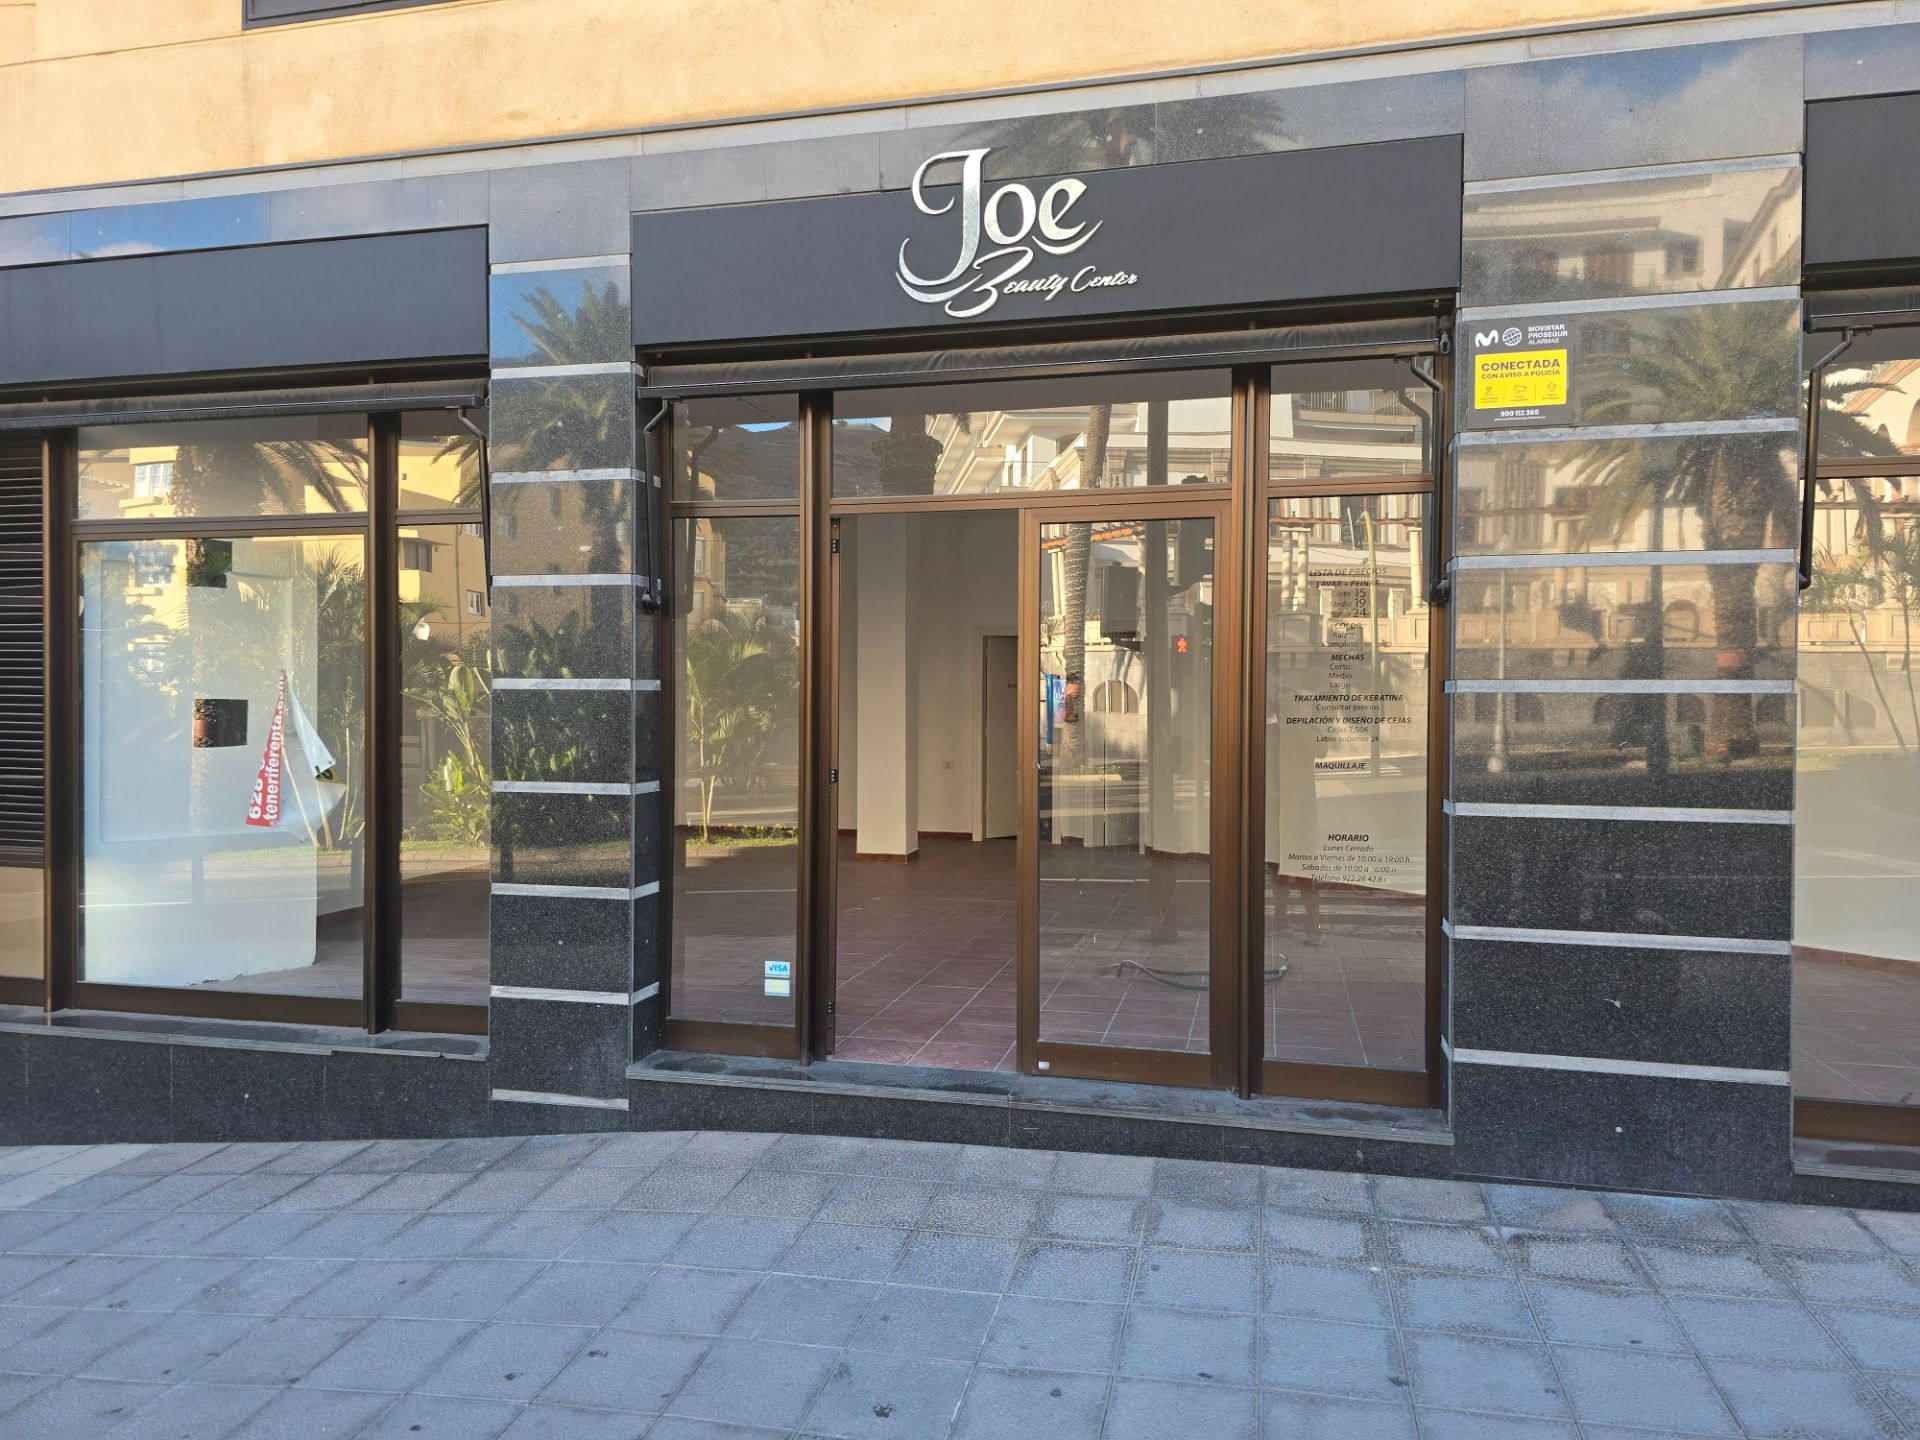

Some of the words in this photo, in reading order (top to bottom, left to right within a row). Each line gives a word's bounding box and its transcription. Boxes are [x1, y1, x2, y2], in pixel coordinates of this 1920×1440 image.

[897, 147, 1095, 292] Joe
[944, 246, 1068, 317] Beauty
[1070, 265, 1139, 292] Center
[1528, 324, 1565, 332] MOVISTAR
[1528, 331, 1568, 339] PROSEGUR
[1481, 358, 1560, 372] CONECTADA
[1531, 368, 1560, 377] POLICÍA
[1309, 568, 1333, 577] LISTA
[1334, 568, 1347, 576] DE
[1349, 567, 1388, 575] PRECIOS
[1316, 580, 1342, 588] LAVAR
[1355, 588, 1366, 598] 15
[1354, 599, 1366, 608] 19
[1294, 694, 1350, 702] TRATAMIENTO
[1351, 694, 1362, 702] DE
[1363, 694, 1404, 702] KERATINA
[1353, 704, 1380, 712] precios
[1286, 716, 1334, 724] DEPILACIÓN
[1342, 715, 1373, 724] DISEÑO
[1339, 736, 1369, 744] superior
[1315, 762, 1366, 770] MAQUILLAJE
[1328, 834, 1369, 842] HORARIO
[1345, 845, 1374, 853] Cerrado
[1288, 853, 1312, 861] Martes
[1320, 854, 1346, 862] Viernes
[1346, 854, 1356, 862] de
[1357, 855, 1377, 863] 10:00
[1301, 864, 1332, 872] Sábados
[1344, 865, 1363, 873] 10:00
[769, 964, 788, 972] VISA
